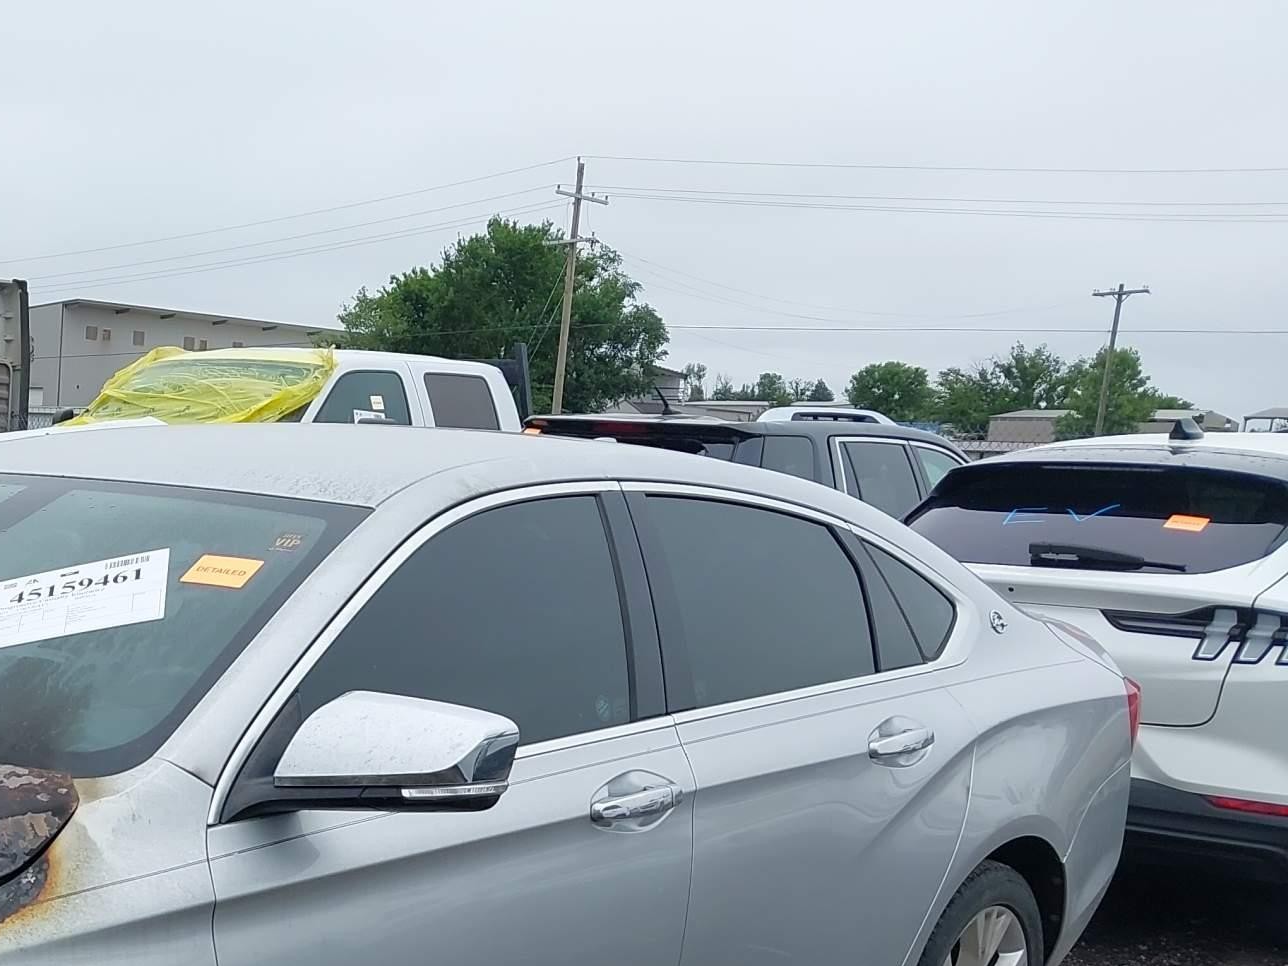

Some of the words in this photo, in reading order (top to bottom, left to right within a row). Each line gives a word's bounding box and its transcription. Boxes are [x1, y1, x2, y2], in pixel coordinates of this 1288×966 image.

[1002, 503, 1121, 526] EV
[275, 537, 301, 548] VIP
[196, 566, 247, 577] DETAILED
[9, 567, 144, 604] 45159461
